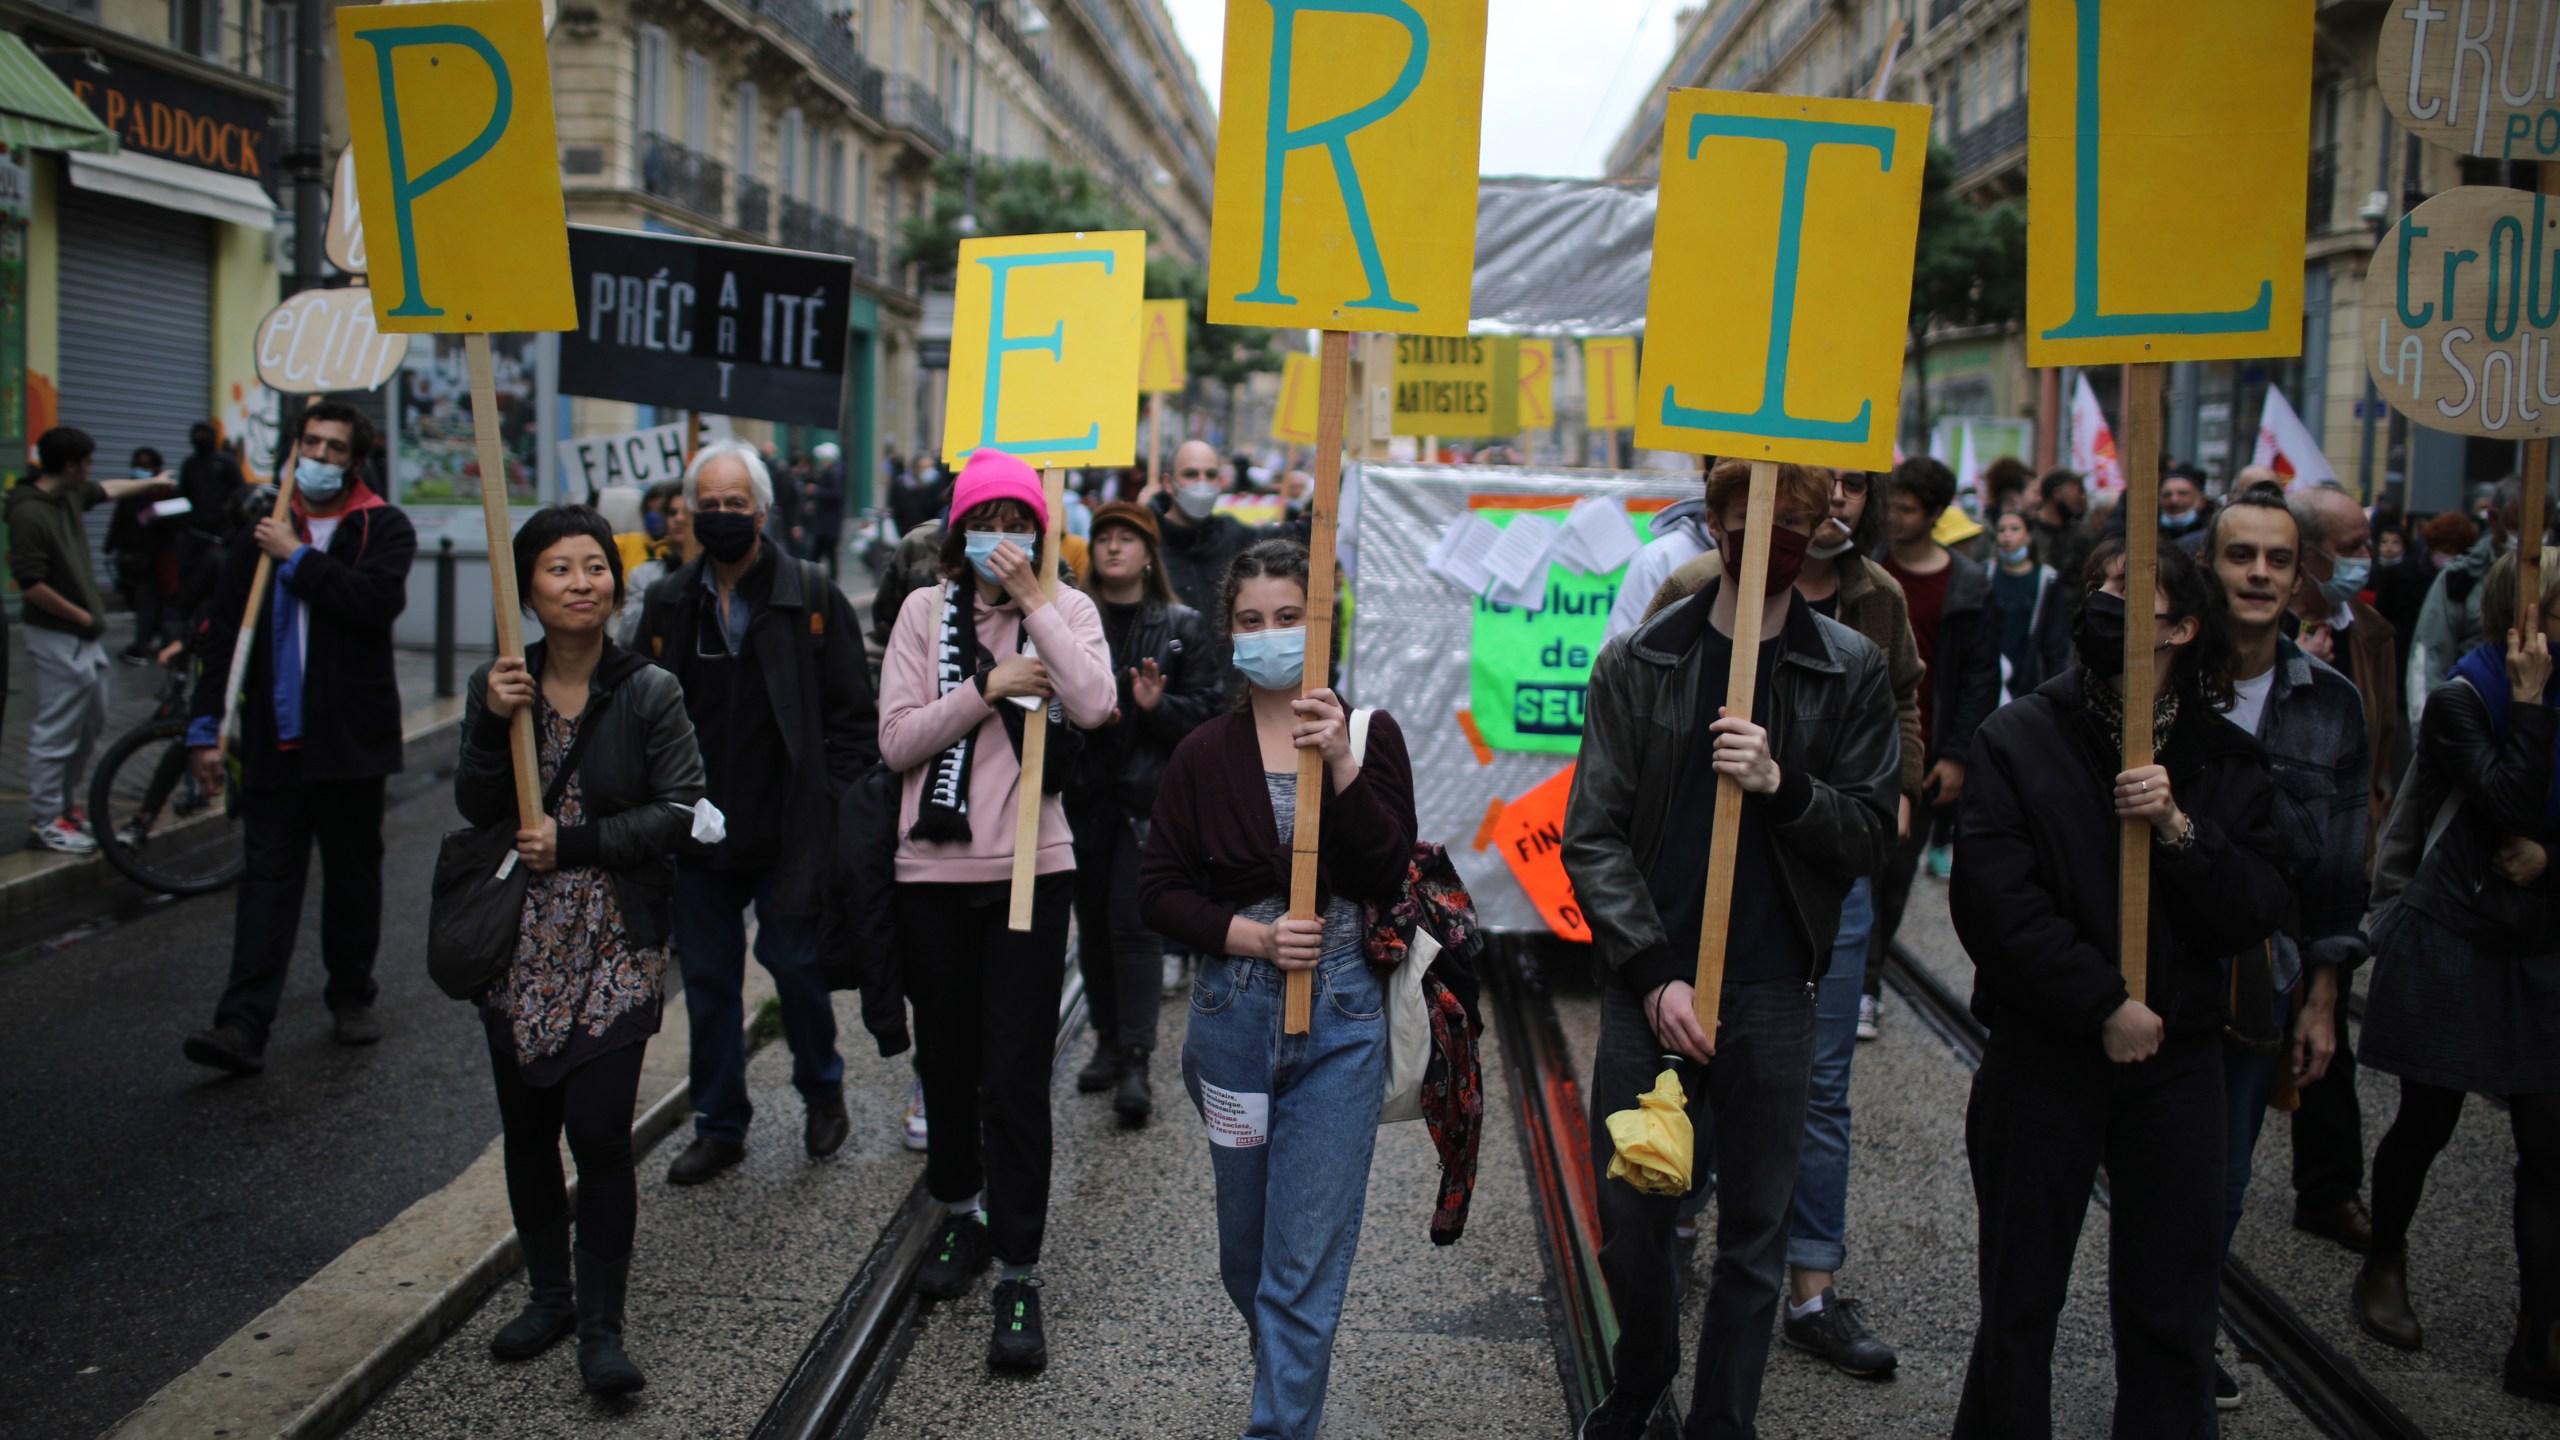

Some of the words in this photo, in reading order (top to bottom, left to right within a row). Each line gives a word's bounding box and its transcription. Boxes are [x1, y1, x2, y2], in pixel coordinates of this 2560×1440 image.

[107, 88, 262, 177] PADDOCK
[355, 24, 513, 317] P
[1234, 0, 1430, 313] R
[2041, 0, 2273, 340] L
[956, 249, 1115, 457] E
[1396, 379, 1488, 415] ARTISTES
[1541, 637, 1589, 668] de
